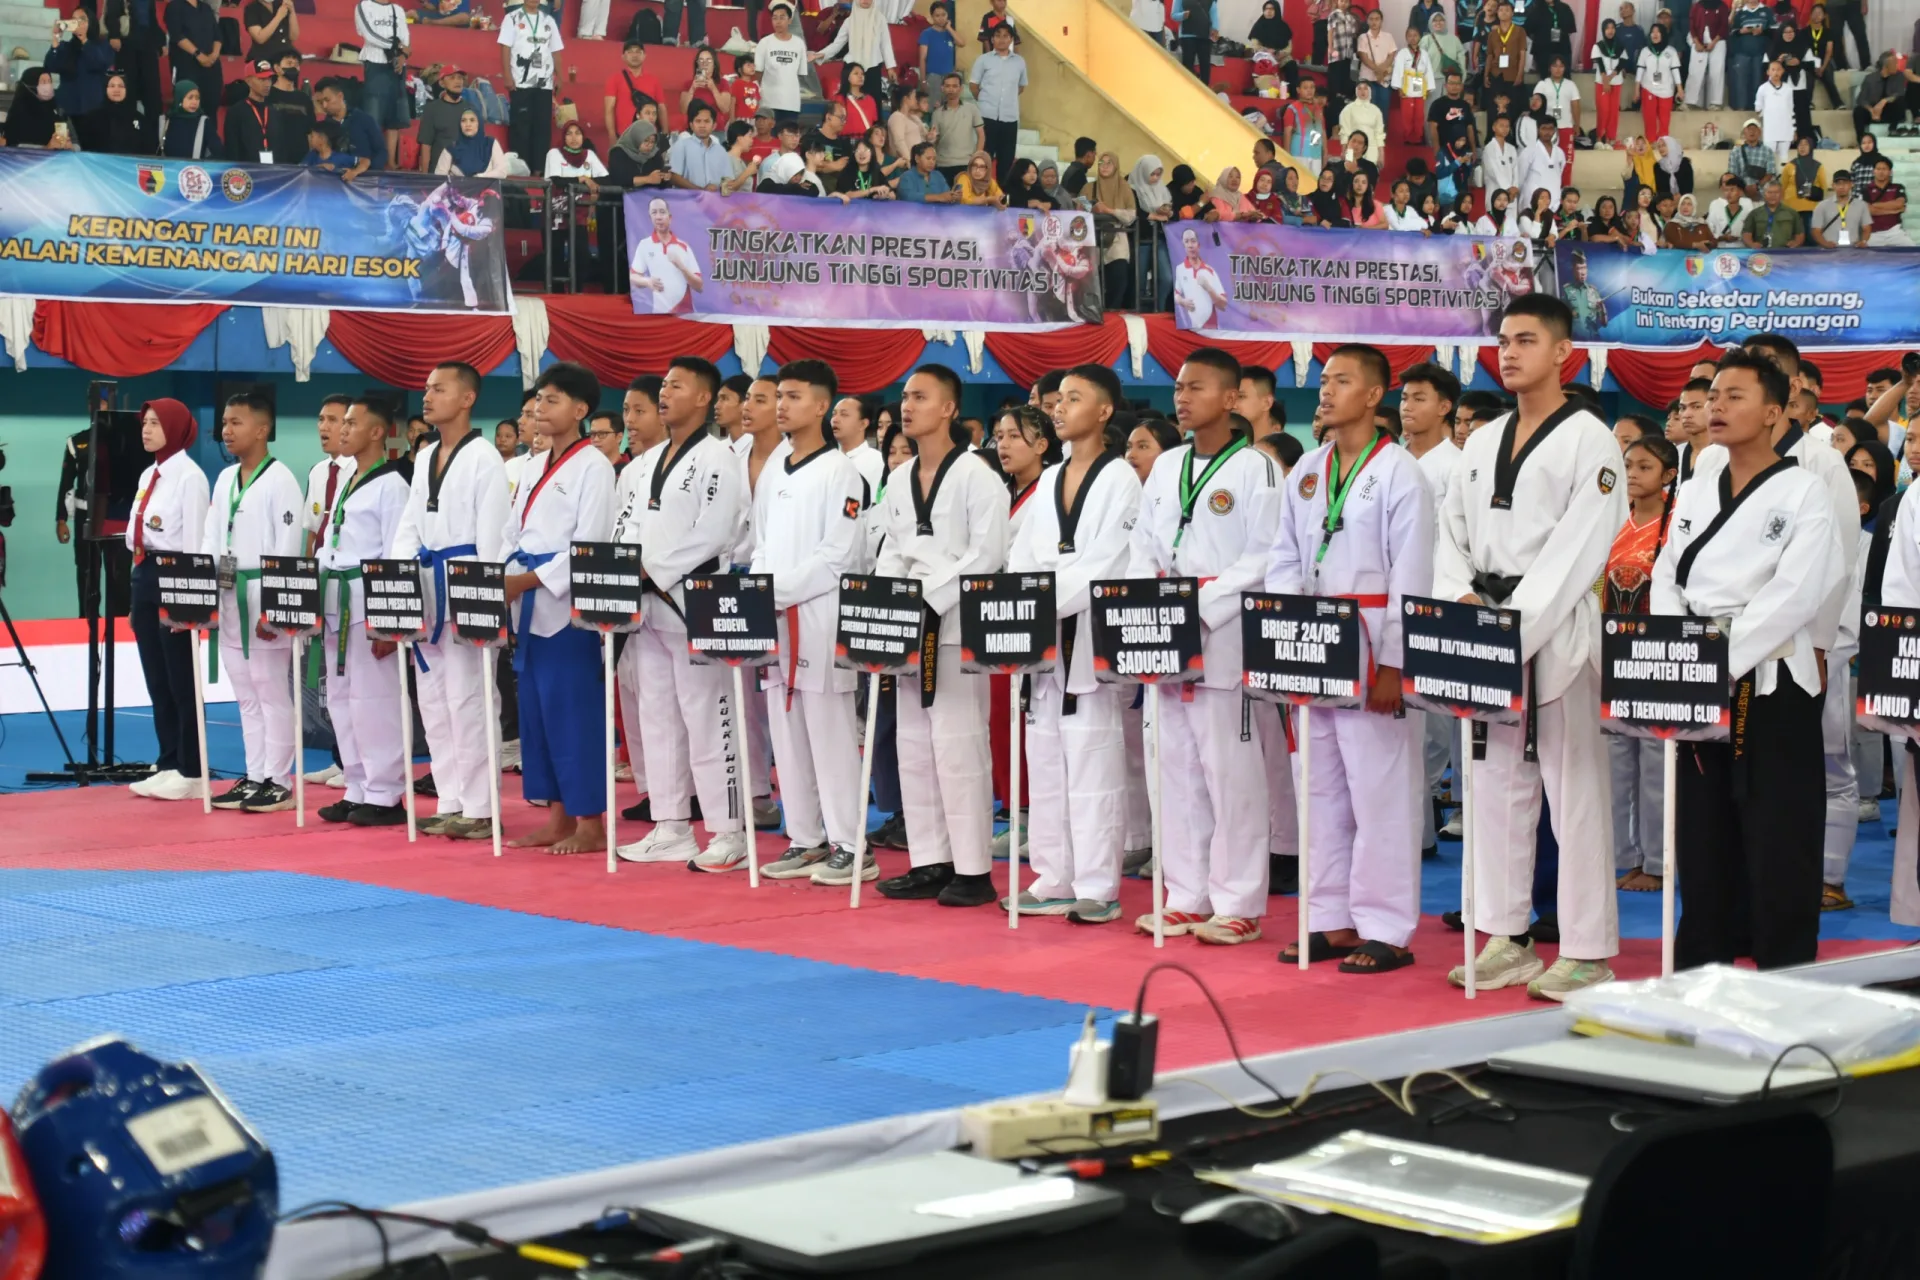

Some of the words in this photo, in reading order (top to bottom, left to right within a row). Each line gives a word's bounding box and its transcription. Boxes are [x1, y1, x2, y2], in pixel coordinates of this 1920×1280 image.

[68, 215, 207, 245] KERINGAT
[213, 224, 278, 247] HARI
[285, 227, 320, 248] INI
[707, 228, 866, 257] TINGKATKAN
[871, 236, 983, 263] PRESTASI,
[0, 238, 79, 263] ALAH
[86, 243, 279, 273] KEMENANGAN
[285, 254, 347, 275] HARI
[353, 257, 421, 279] ESOK
[1228, 254, 1349, 280] TINGKATKAN
[1355, 260, 1442, 284] PRESTASI,
[711, 259, 820, 285] JUNJUNG
[830, 264, 901, 287] TINGGI
[907, 268, 1048, 294] SPORTIVITAS
[1233, 281, 1315, 304] JUNJUNG
[1323, 284, 1380, 305] TINGGI
[1385, 287, 1499, 310] SPORTIVITAS
[1631, 287, 1674, 308] Bukan
[1678, 289, 1761, 309] Sekedar
[1766, 290, 1864, 310] Menang,
[1636, 311, 1653, 328] Ini
[1656, 312, 1723, 333] Tentang
[1729, 311, 1860, 333] Perjuangan
[286, 577, 317, 590] TAEKWONDO
[288, 594, 302, 606] CLUB
[719, 597, 738, 614] SPC
[980, 601, 1014, 621] POLDA
[1016, 600, 1037, 620] NTT
[495, 615, 499, 628] 2
[712, 618, 748, 632] REDDEVIL
[889, 609, 920, 623] LAMONGAN
[1106, 607, 1157, 627] RAJAWALI
[1159, 606, 1185, 625] CLUB
[868, 622, 902, 637] TAEKWONDO
[903, 626, 917, 639] CLUB
[1121, 626, 1171, 644] SIDOARJO
[1261, 619, 1298, 641] BRIGIF
[1301, 622, 1340, 645] 24/BC
[692, 638, 727, 651] KABUPATEN
[727, 639, 775, 651] KARANGANYAR
[850, 637, 865, 650] BLACK
[866, 639, 884, 652] HORSE
[885, 641, 904, 654] SQUAD
[985, 633, 1031, 653] MARINIR
[1275, 641, 1326, 664] KALTARA
[1408, 633, 1439, 653] KODAM
[1441, 638, 1516, 665] XII/TANJUNGPURA
[1631, 640, 1666, 660] KODIM
[1668, 642, 1698, 662] 0809
[1117, 650, 1180, 674] SADUCAN
[1613, 660, 1679, 682] KABAUPATEN
[1682, 663, 1717, 683] KEDIRI
[1892, 657, 1920, 680] BAN
[1248, 671, 1268, 689] 532
[1270, 673, 1319, 694] PANGERAN
[1322, 677, 1354, 697] TIMUR
[1414, 675, 1469, 701] KABUPATEN
[1471, 684, 1511, 708] MADIUN
[1610, 700, 1630, 718] AGS
[1632, 701, 1692, 722] TAEKWONDO
[1694, 704, 1721, 724] CLUB
[1865, 694, 1910, 718] LANUD
